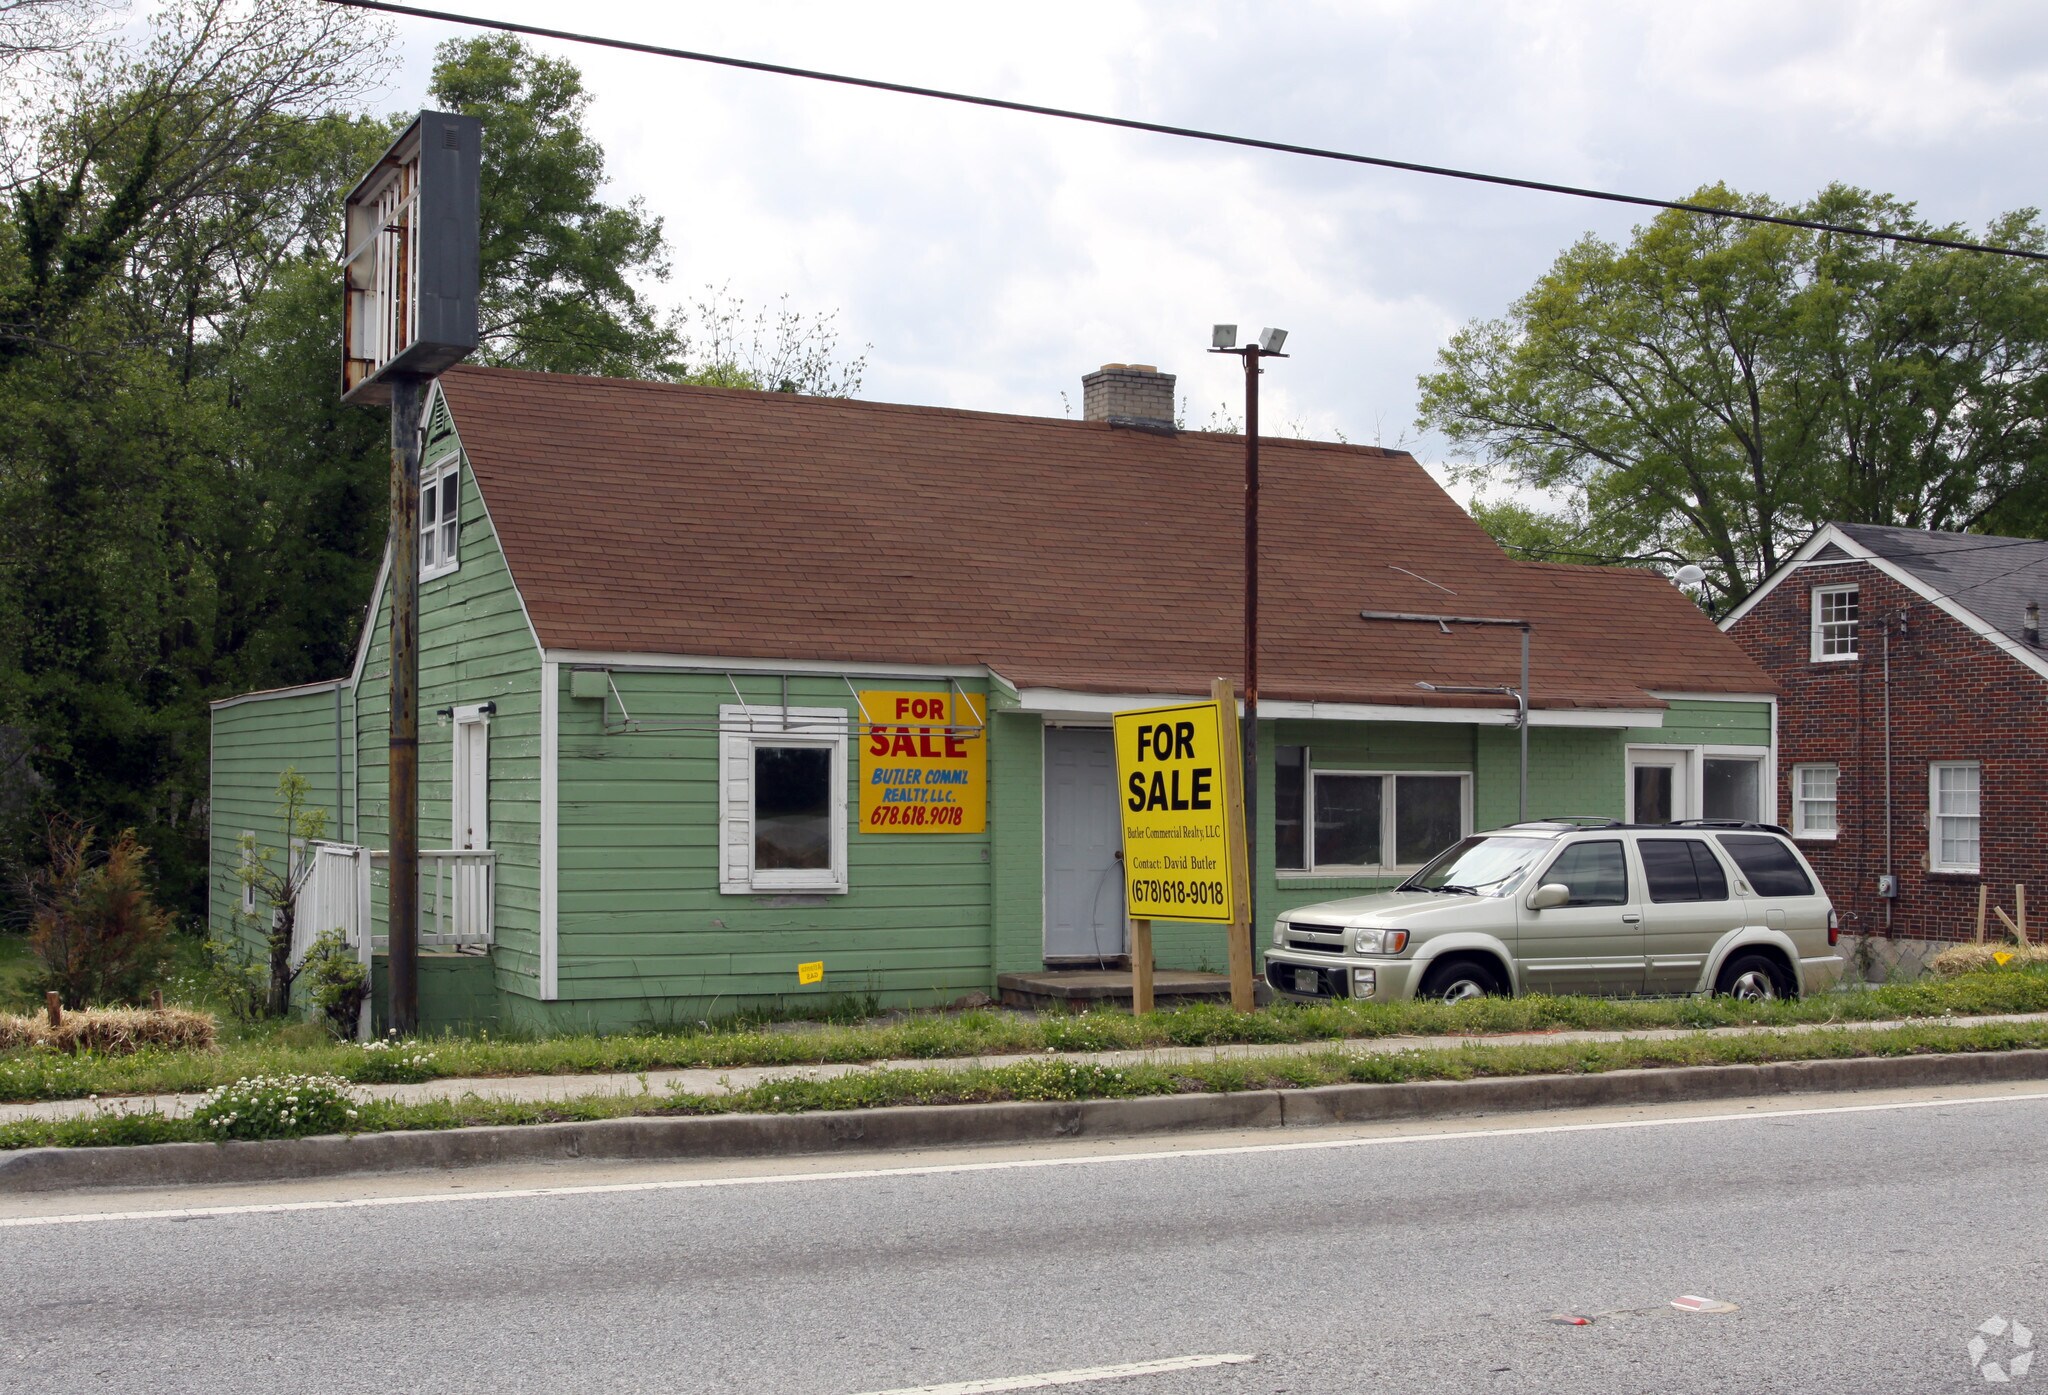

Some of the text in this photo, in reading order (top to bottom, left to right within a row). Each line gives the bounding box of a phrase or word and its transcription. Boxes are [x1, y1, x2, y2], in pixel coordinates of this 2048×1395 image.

[895, 697, 945, 720] FOR
[869, 724, 968, 758] SALE
[1137, 721, 1195, 762] FOR
[871, 768, 922, 785] BUTLER
[1128, 768, 1213, 812] SALE
[870, 805, 964, 826] 678.618.9018
[1127, 825, 1221, 841] Butler Commercial Realty, LLC
[1133, 855, 1217, 870] Contact: David Butler
[1132, 879, 1224, 905] (678)618-9018
